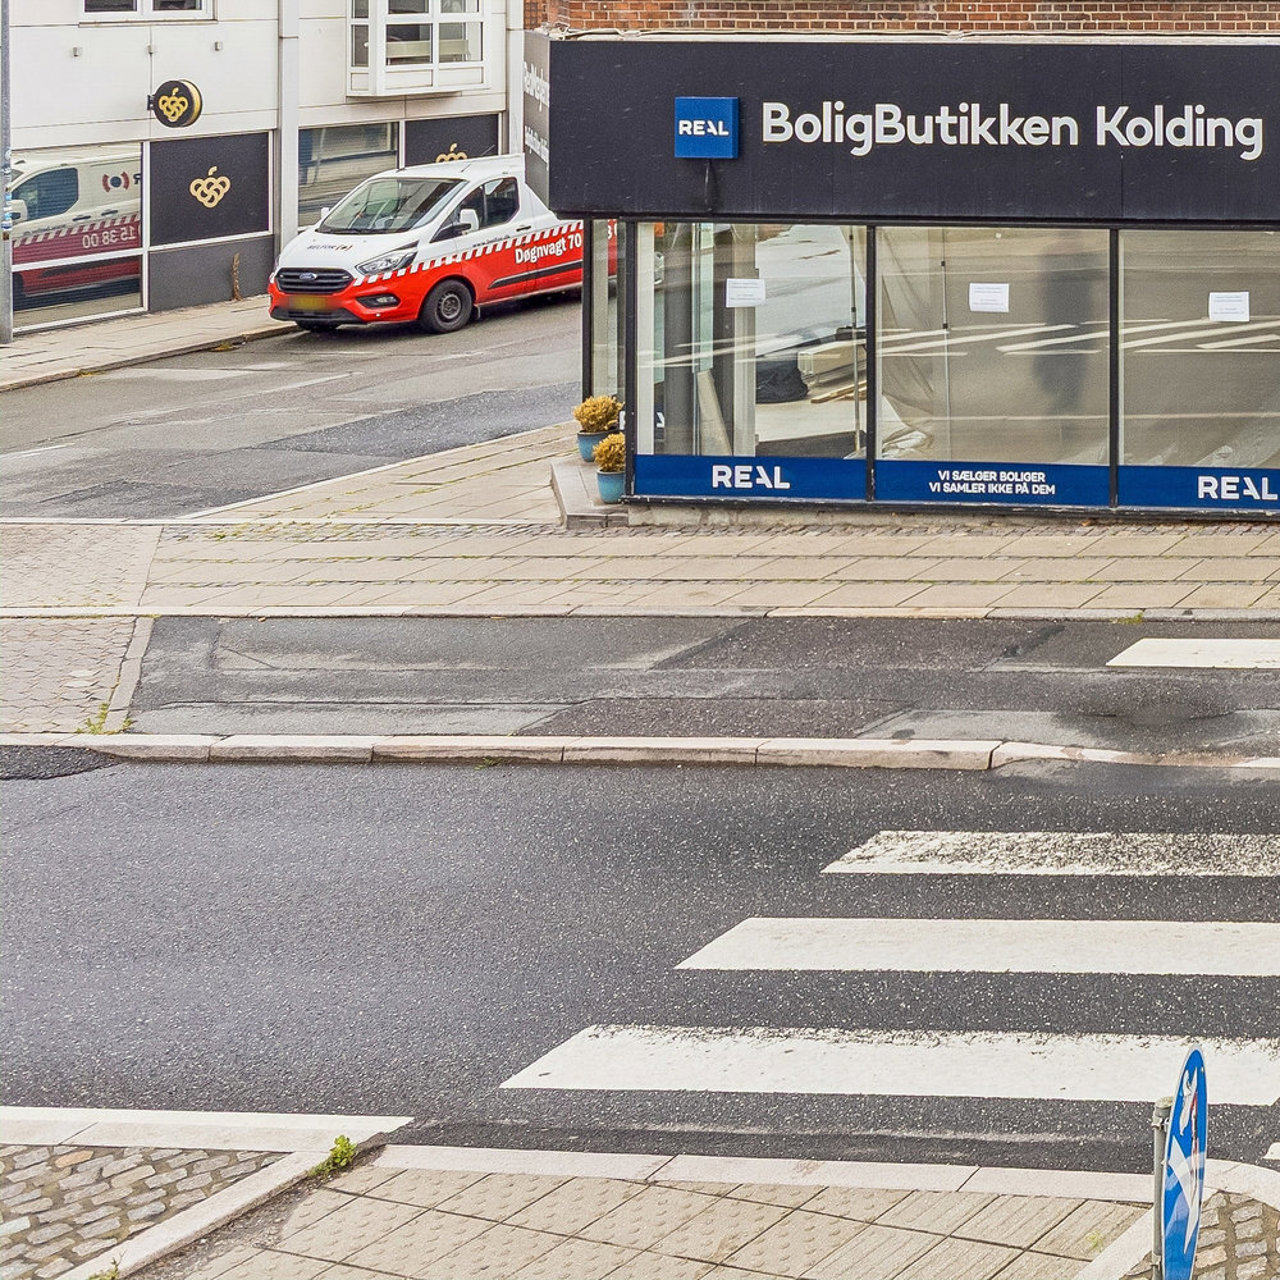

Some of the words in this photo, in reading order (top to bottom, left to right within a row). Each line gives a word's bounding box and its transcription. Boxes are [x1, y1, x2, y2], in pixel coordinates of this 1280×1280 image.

[678, 120, 729, 136] REAL
[762, 101, 1079, 156] BoligButikken
[1096, 104, 1264, 160] Kolding
[515, 237, 567, 264] Døgnvagt
[568, 233, 582, 249] 70
[712, 465, 791, 489] REAL
[929, 483, 941, 493] VI
[943, 483, 986, 494] SAMLER
[988, 484, 1013, 494] IKKE
[1015, 482, 1029, 495] PÅ
[1032, 484, 1055, 495] DEM
[938, 470, 950, 481] VI
[952, 471, 997, 482] SÆLGER
[1000, 472, 1046, 483] BOLIGER
[1198, 476, 1278, 500] REAL
